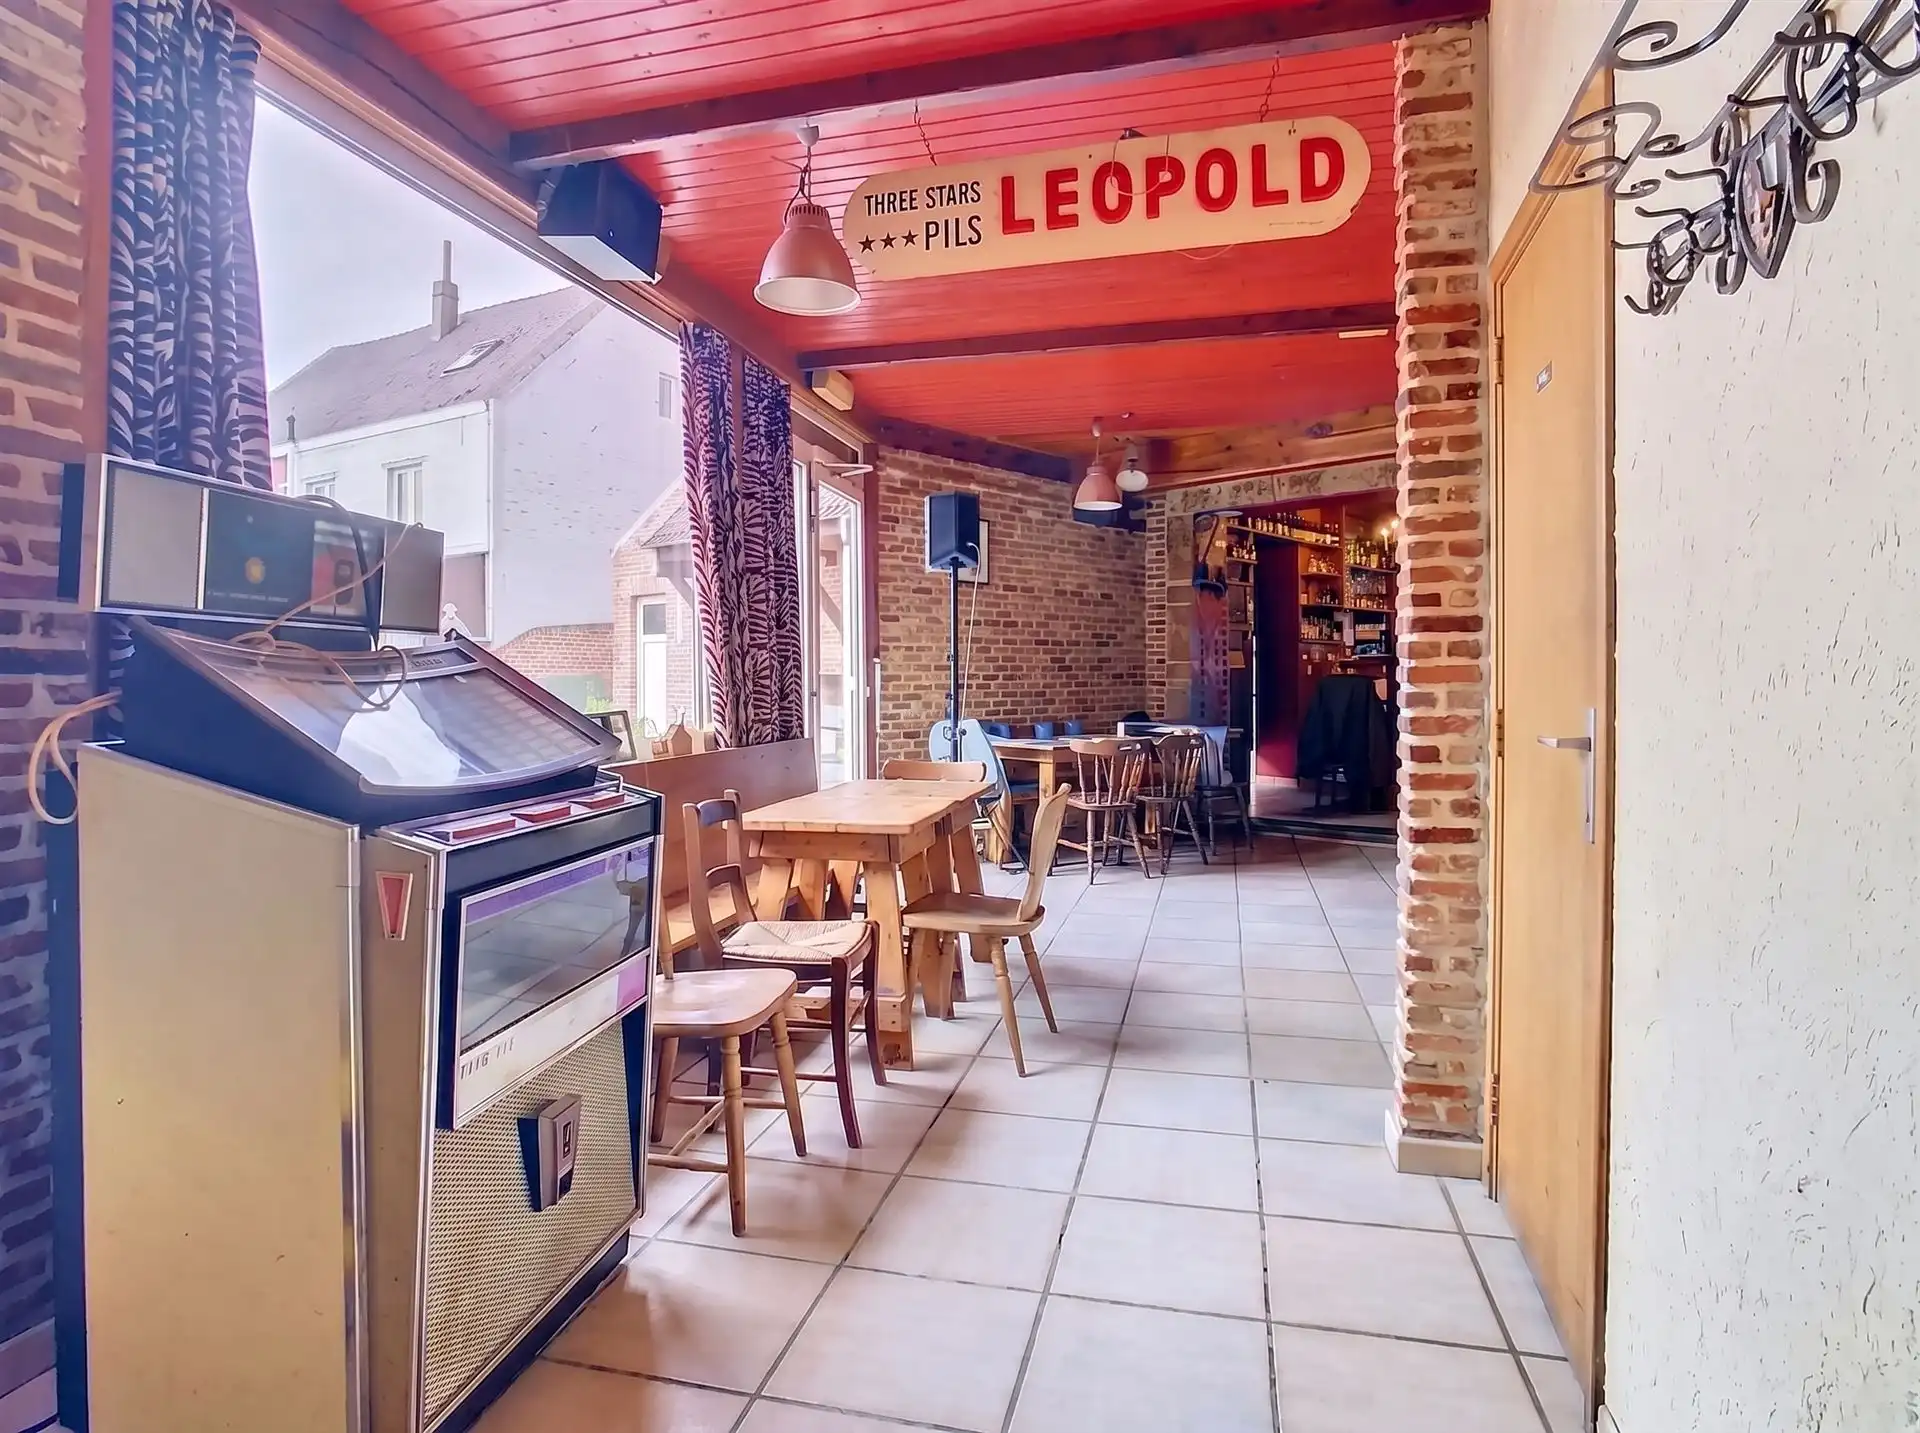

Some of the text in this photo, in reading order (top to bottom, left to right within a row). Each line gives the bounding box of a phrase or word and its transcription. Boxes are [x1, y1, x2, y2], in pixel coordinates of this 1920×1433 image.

[864, 181, 981, 216] THREE STARS
[1001, 137, 1345, 235] LEOPOLD
[925, 215, 982, 250] PILS
